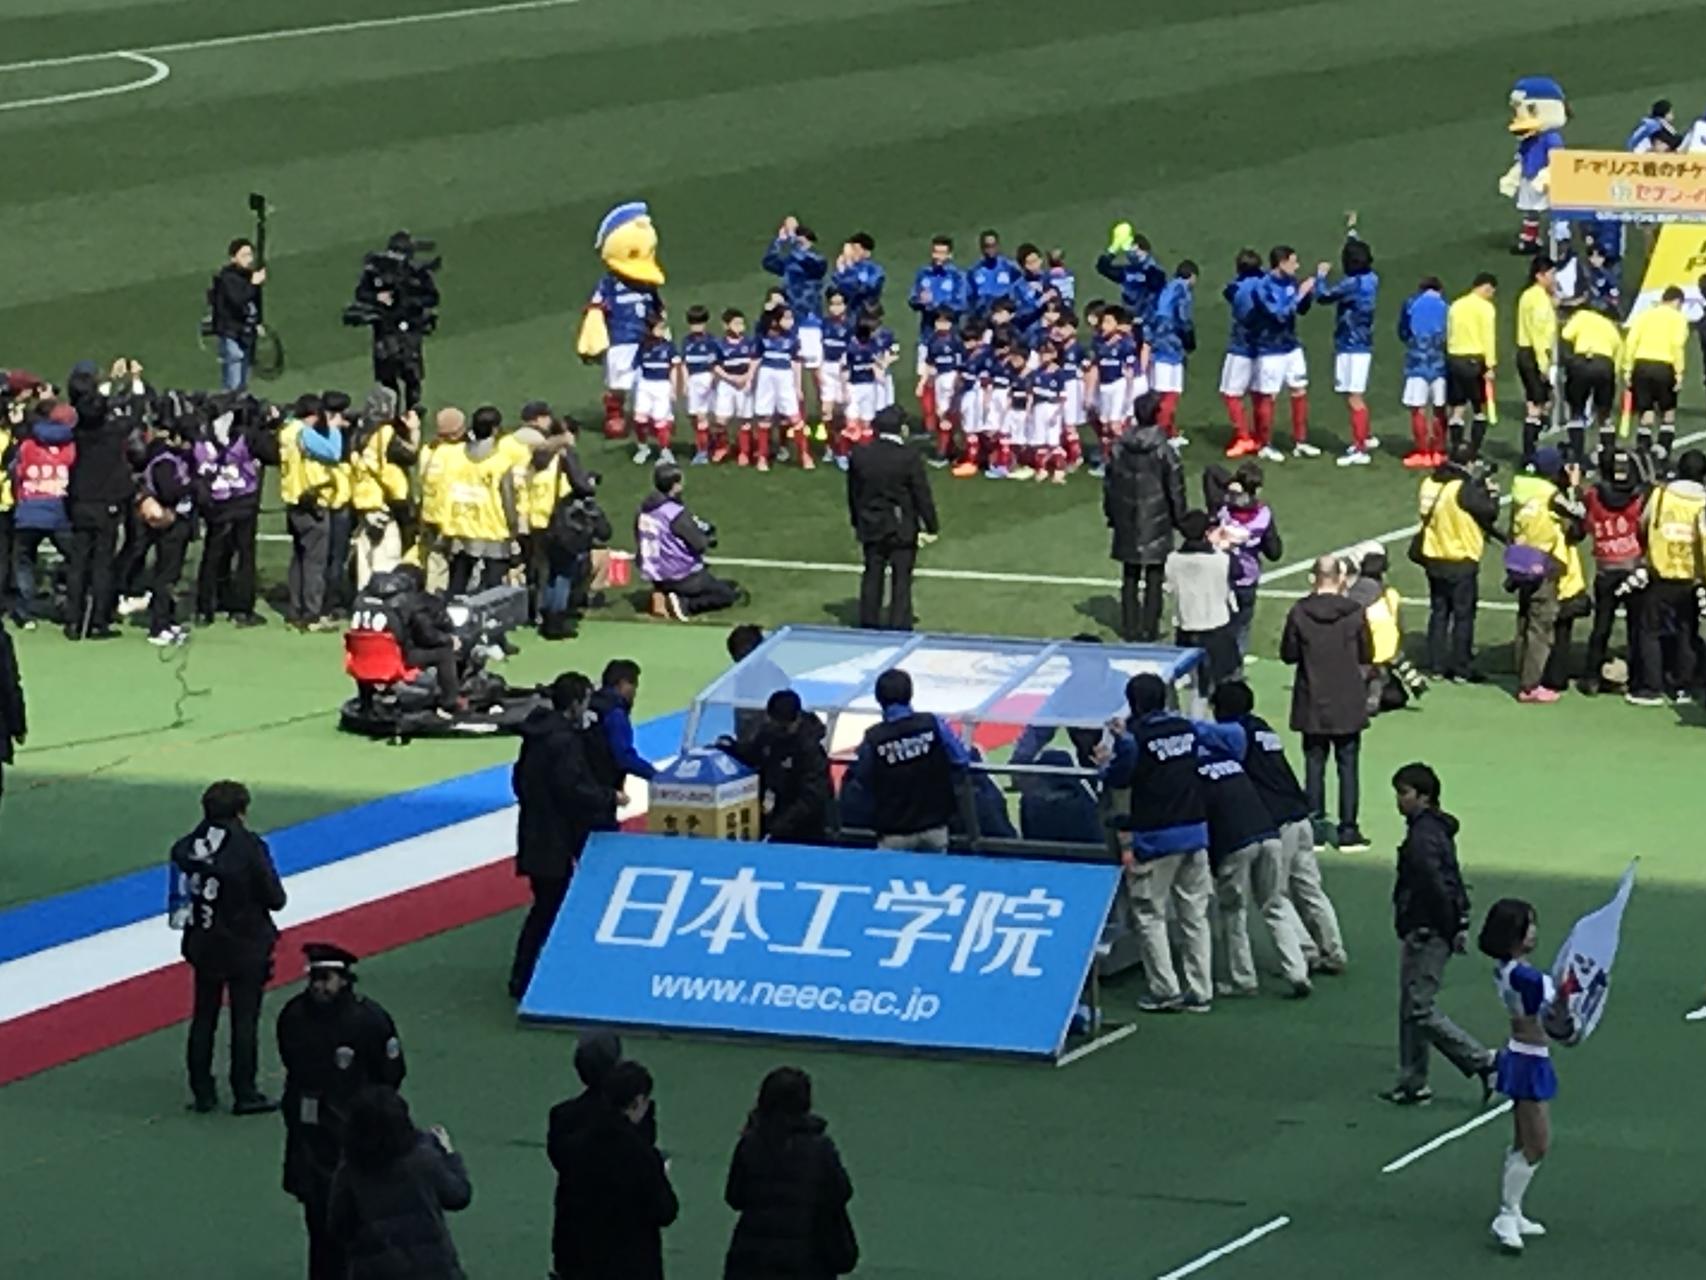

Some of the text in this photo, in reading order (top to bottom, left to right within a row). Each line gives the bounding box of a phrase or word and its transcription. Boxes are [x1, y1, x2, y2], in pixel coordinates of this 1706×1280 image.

[594, 866, 1065, 978] 日本工学院
[651, 972, 941, 1022] www.neec.ac.jp
